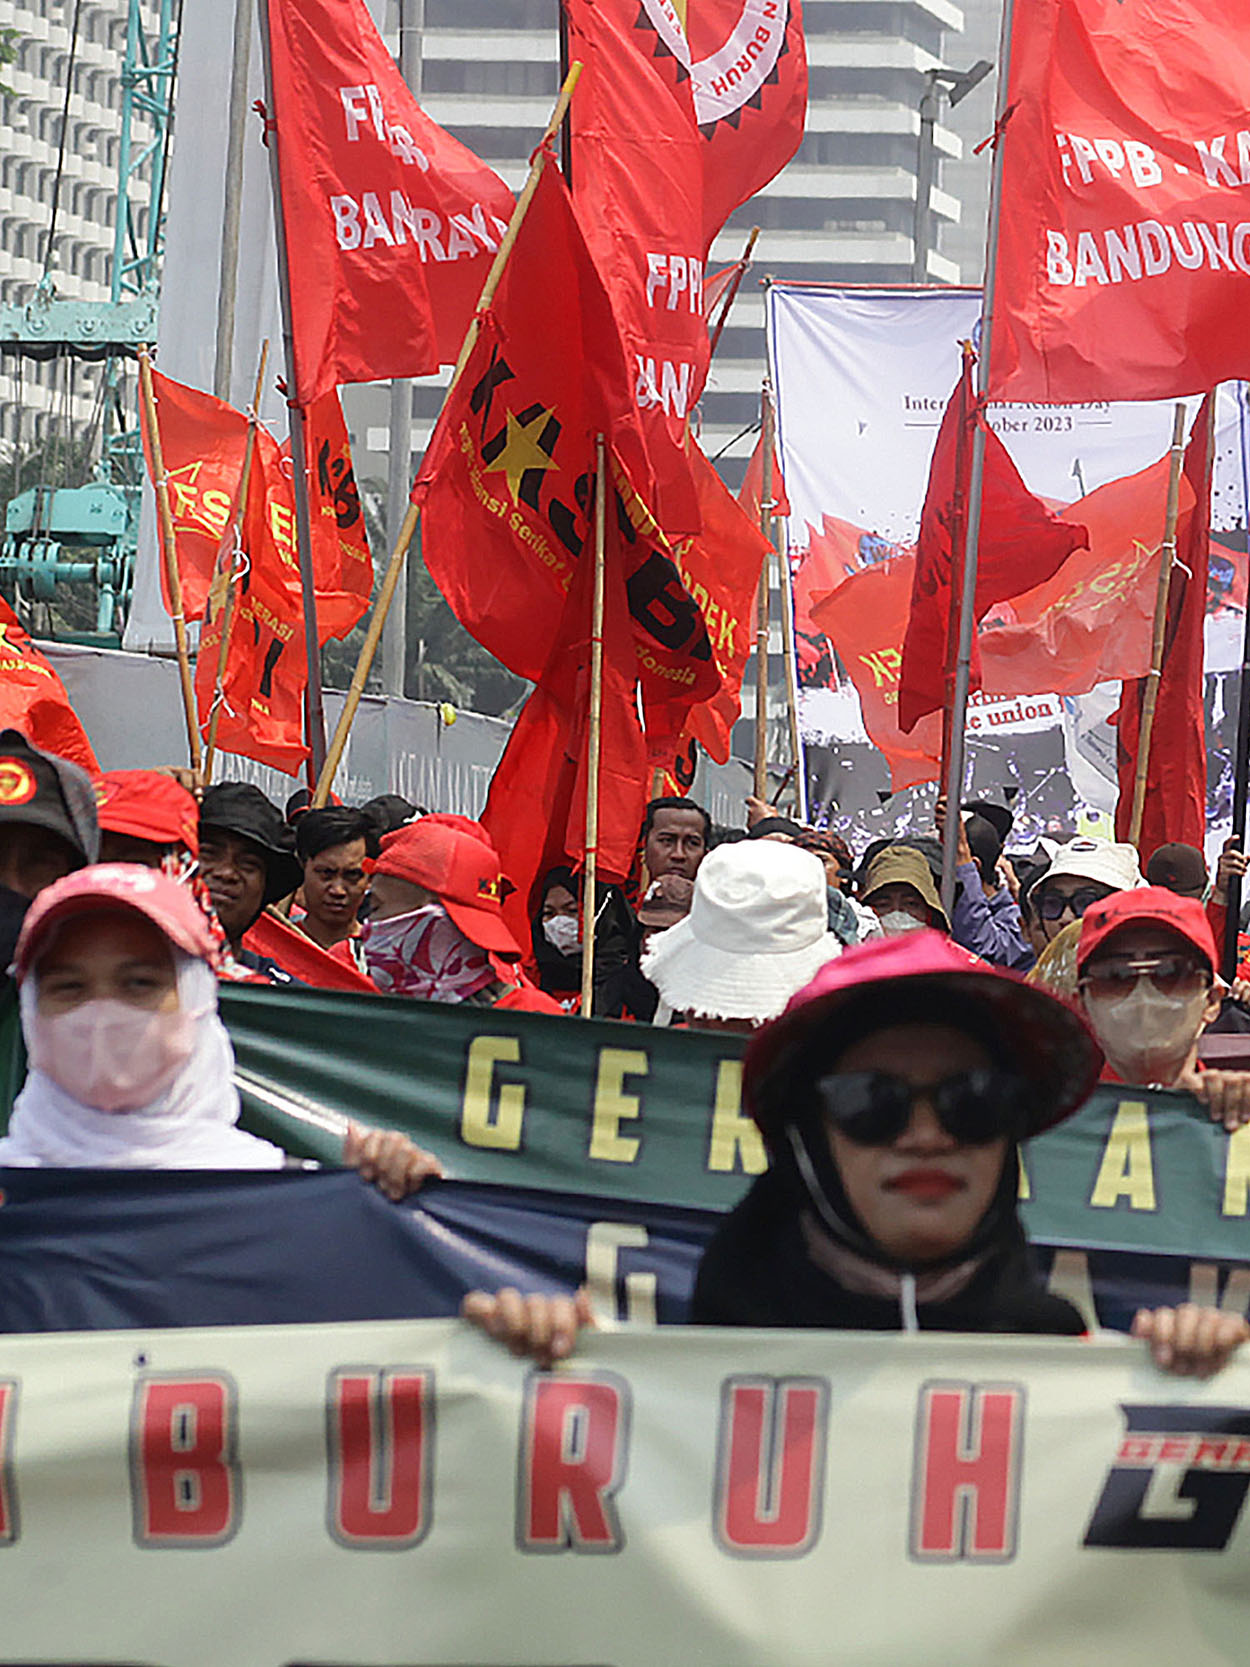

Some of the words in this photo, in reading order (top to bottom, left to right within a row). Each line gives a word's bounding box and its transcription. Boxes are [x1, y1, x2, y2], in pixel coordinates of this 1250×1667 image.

[708, 26, 776, 98] BURUH
[1034, 415, 1073, 432] 2023
[986, 700, 1054, 727] union
